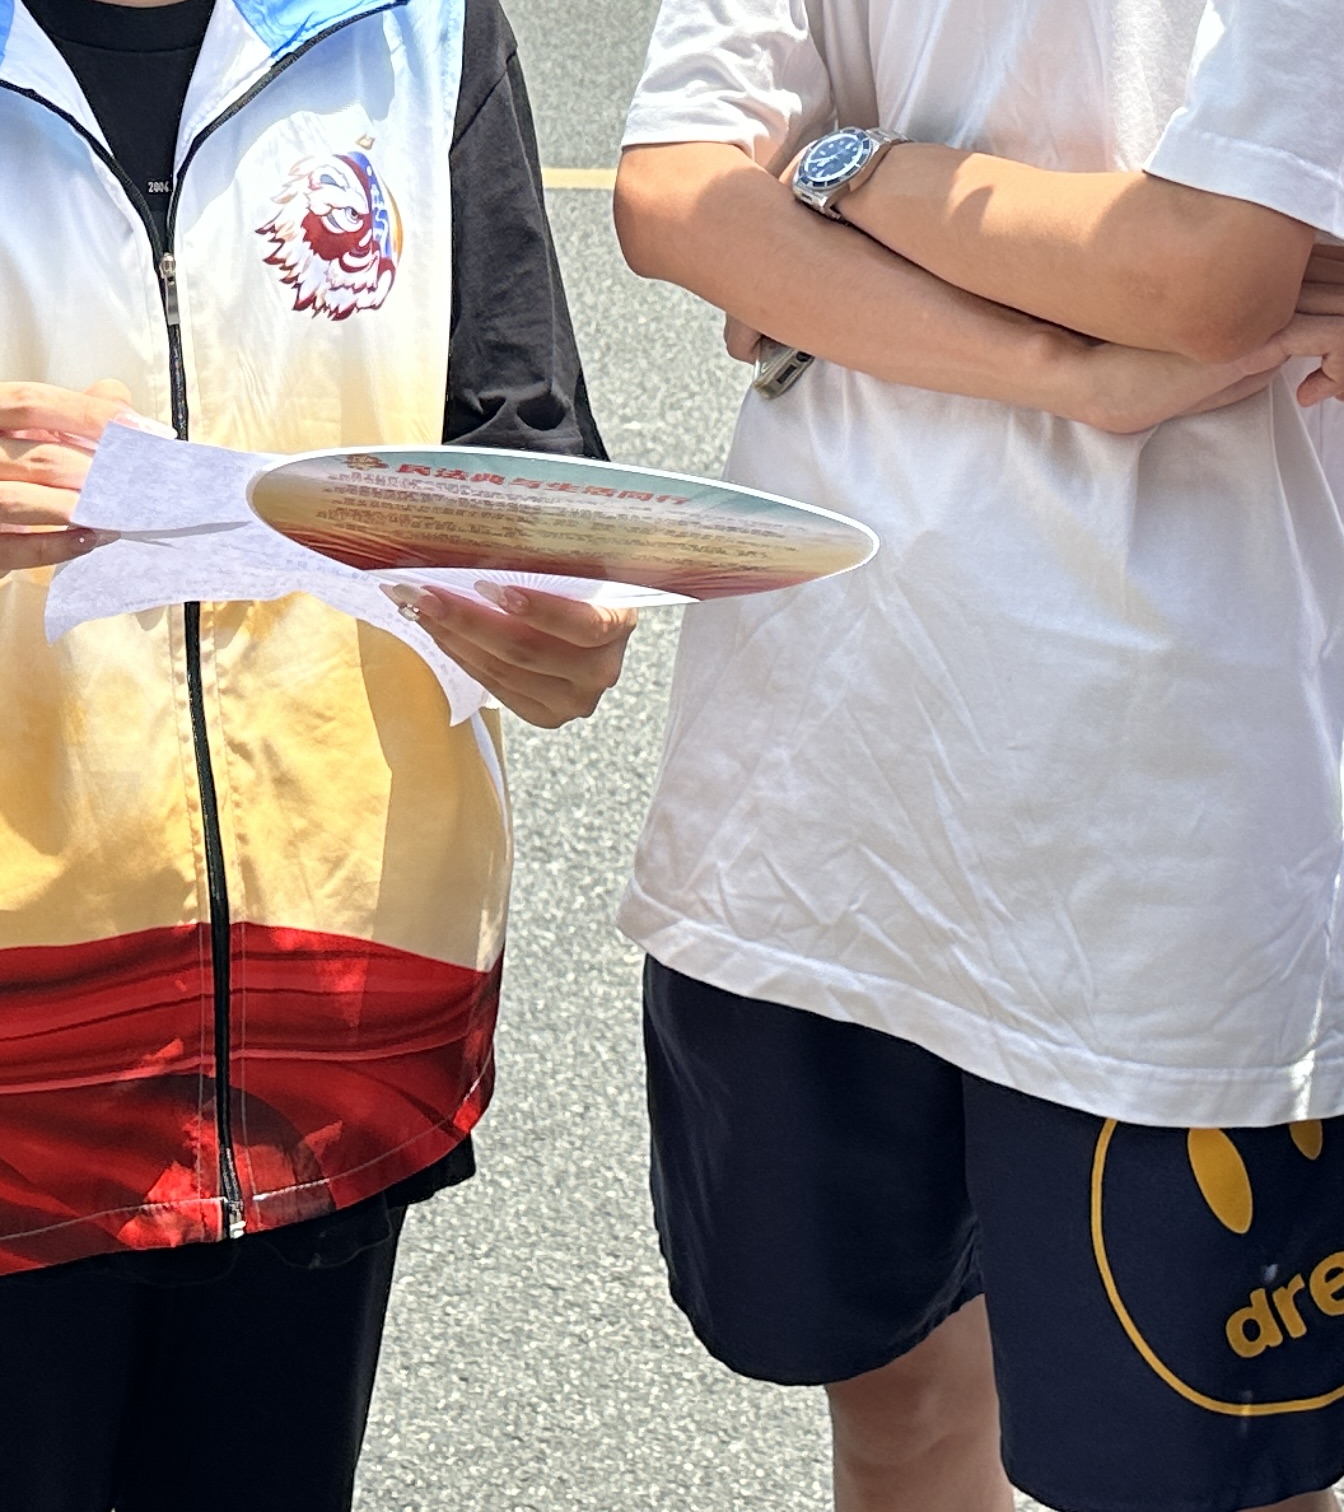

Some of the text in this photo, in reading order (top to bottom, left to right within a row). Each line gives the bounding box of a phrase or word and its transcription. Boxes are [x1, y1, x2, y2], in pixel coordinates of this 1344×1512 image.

[395, 463, 690, 506] 民法典与生活同行
